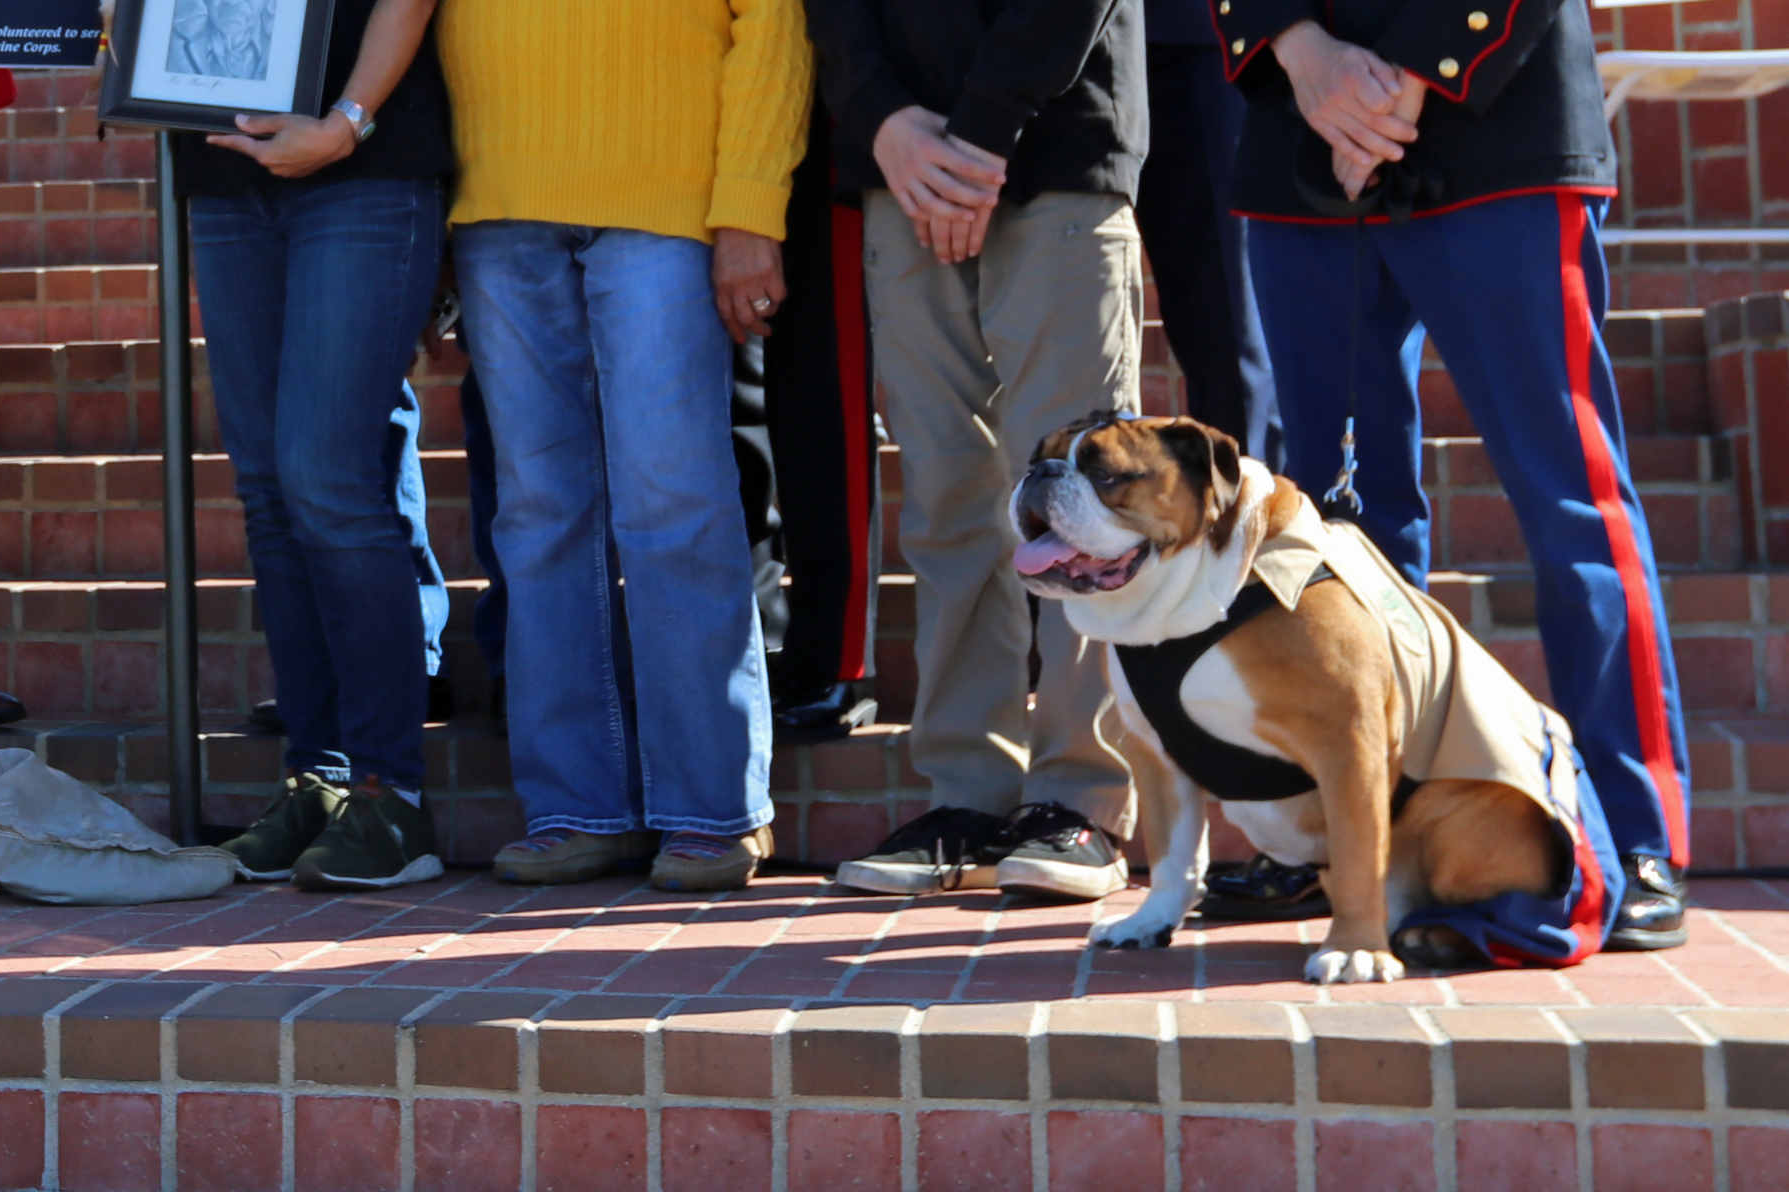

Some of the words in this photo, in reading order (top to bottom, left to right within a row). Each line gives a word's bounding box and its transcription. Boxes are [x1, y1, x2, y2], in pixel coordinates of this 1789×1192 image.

[64, 28, 78, 38] to
[81, 30, 102, 38] ser
[23, 42, 61, 55] Corps.
